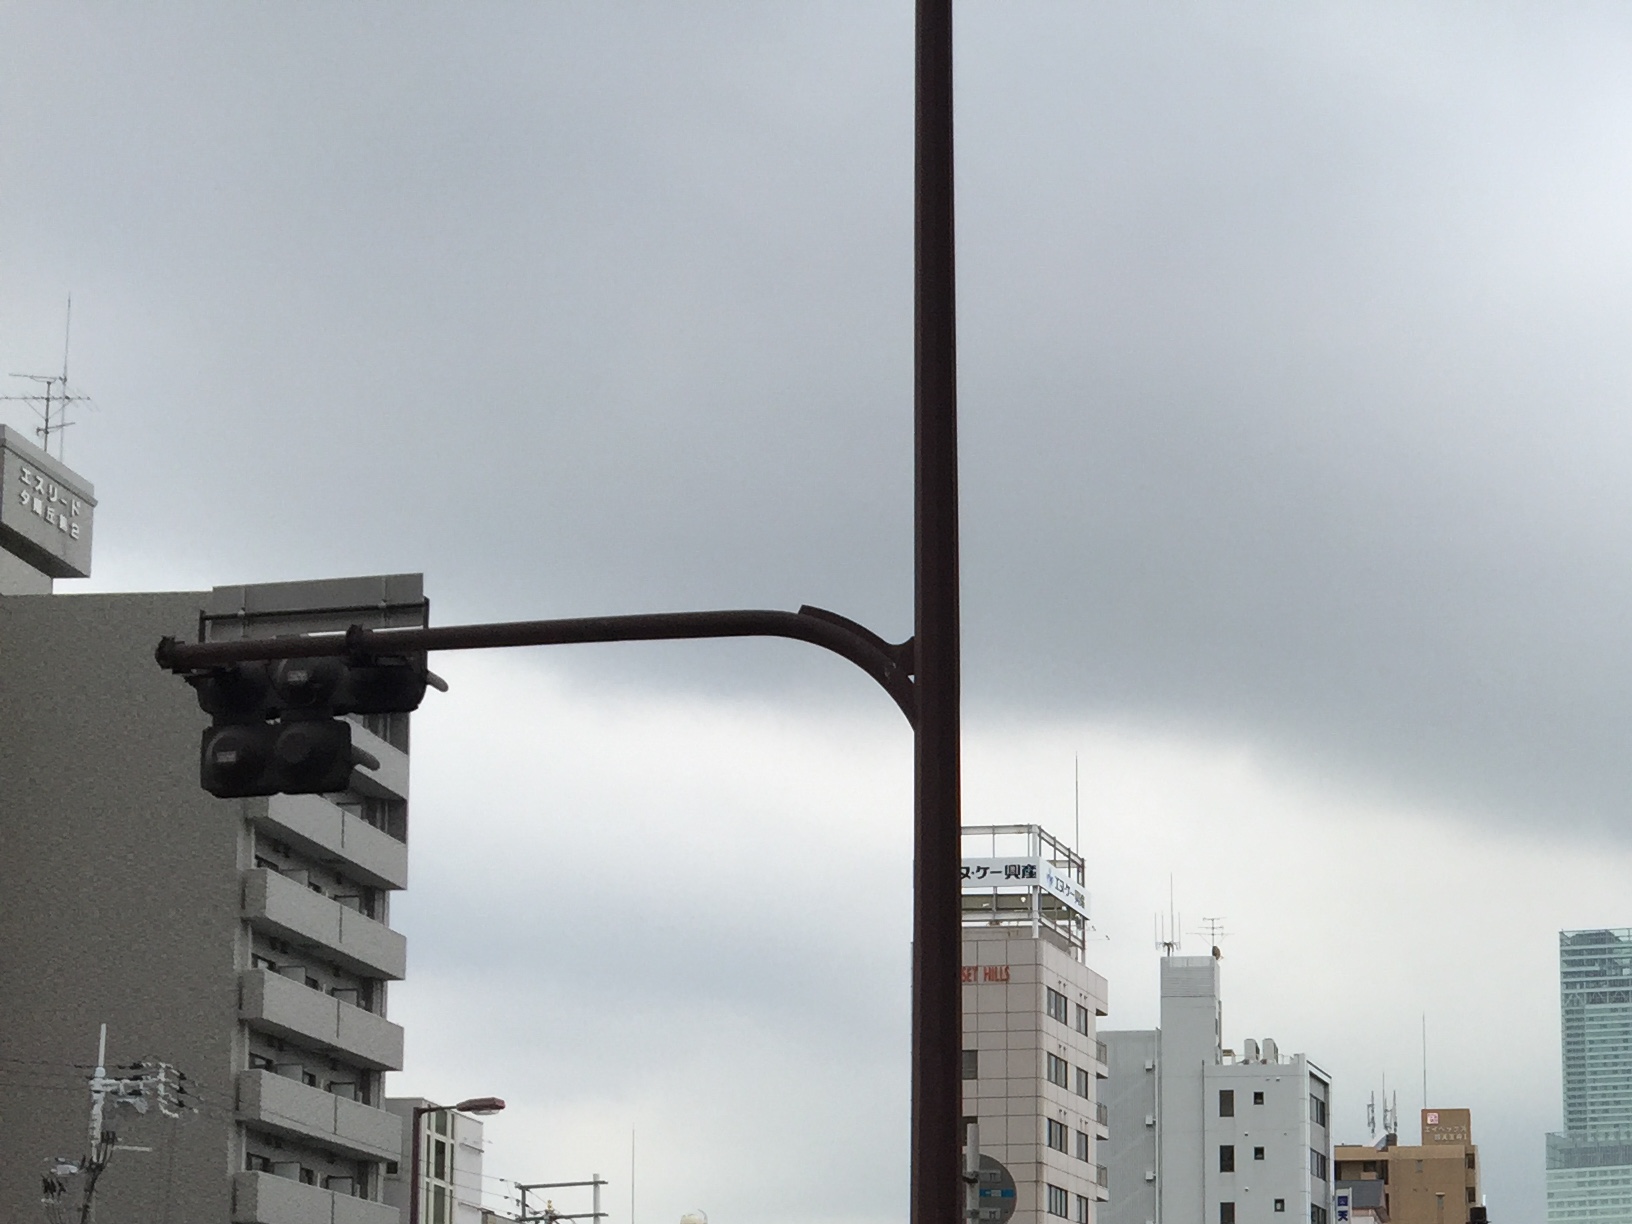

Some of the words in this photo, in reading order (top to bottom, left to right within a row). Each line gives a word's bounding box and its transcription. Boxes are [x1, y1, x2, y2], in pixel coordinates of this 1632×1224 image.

[20, 467, 81, 517] エスリード
[983, 965, 1010, 982] HILLS
